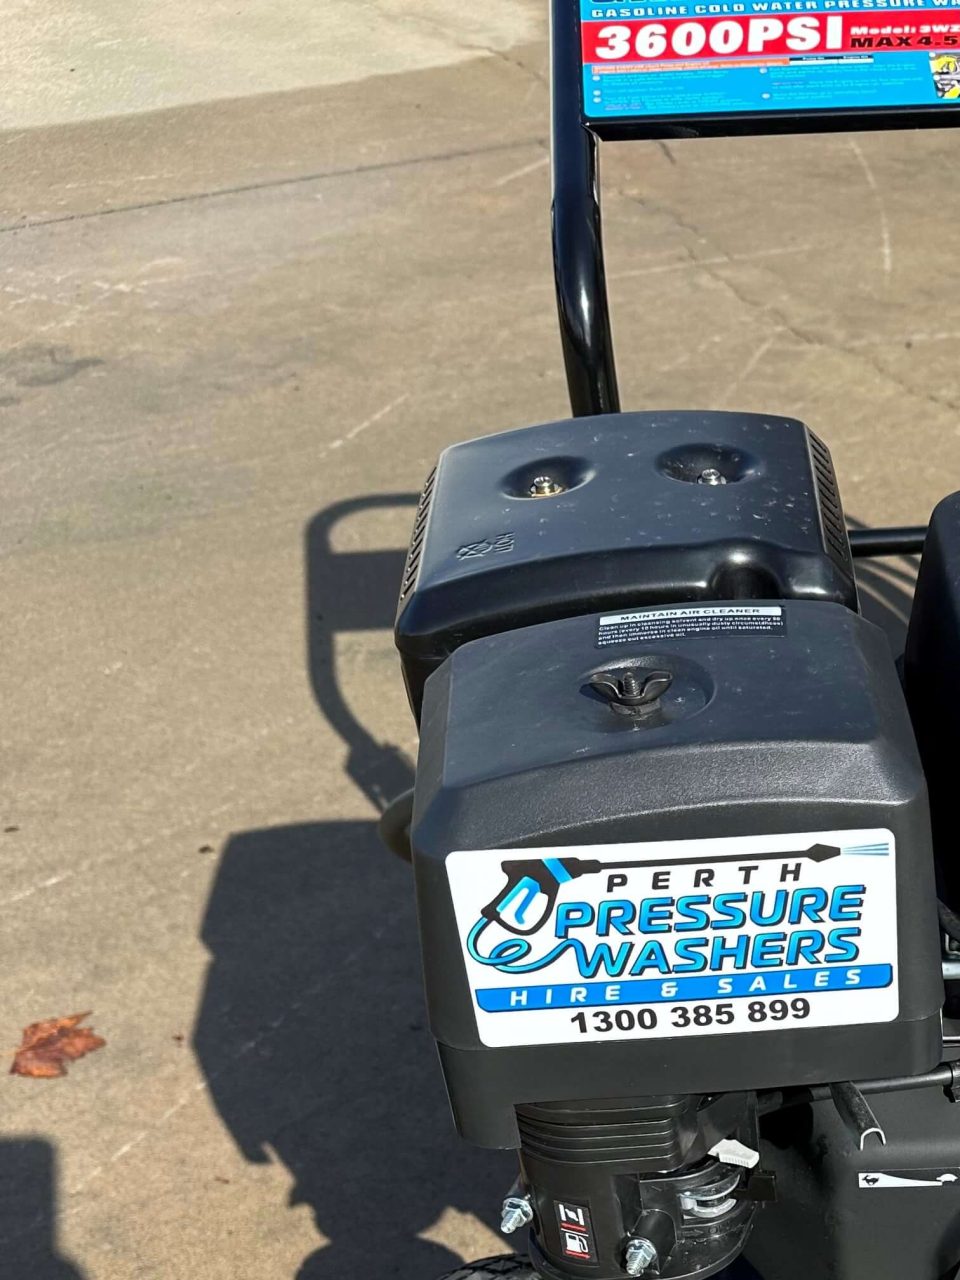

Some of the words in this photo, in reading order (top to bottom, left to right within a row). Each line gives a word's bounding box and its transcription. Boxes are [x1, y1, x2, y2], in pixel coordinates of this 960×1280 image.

[591, 5, 689, 18] GASOLINE
[695, 3, 745, 14] COLD
[751, 0, 818, 11] WATER
[824, 0, 925, 9] PRESSURE
[595, 16, 843, 59] 3600PSI
[850, 24, 916, 35] Model:
[850, 35, 912, 48] MAX
[620, 611, 678, 621] MAINTAIN
[606, 862, 802, 893] PERTH
[554, 884, 867, 939] PRESSURE
[562, 926, 862, 979] WASHERS
[510, 984, 621, 1007] HIRE
[659, 981, 679, 998] &
[716, 968, 862, 995] SALES
[570, 1007, 658, 1034] 1300
[670, 1002, 735, 1028] 385
[747, 997, 811, 1023] 899
